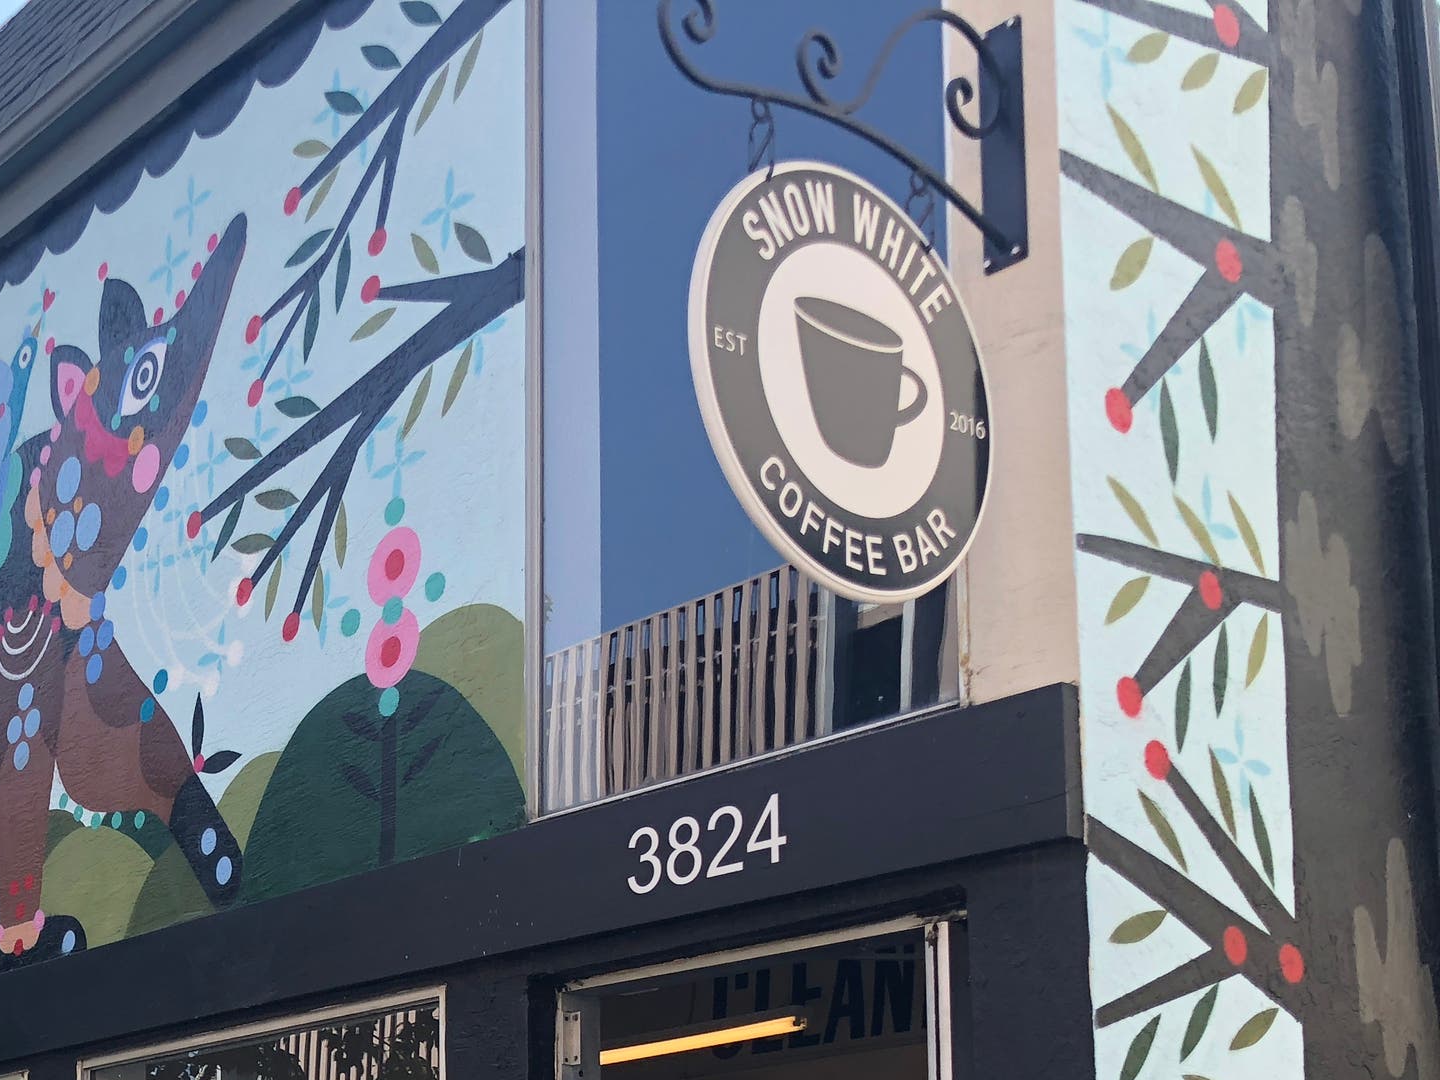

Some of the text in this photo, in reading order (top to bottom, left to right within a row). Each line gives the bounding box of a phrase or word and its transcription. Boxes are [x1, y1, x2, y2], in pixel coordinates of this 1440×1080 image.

[742, 179, 953, 326] SNOW WHITE
[714, 326, 748, 356] EST
[949, 412, 986, 440] 2016
[760, 455, 956, 576] COFFEE BAR
[627, 793, 787, 894] 3824
